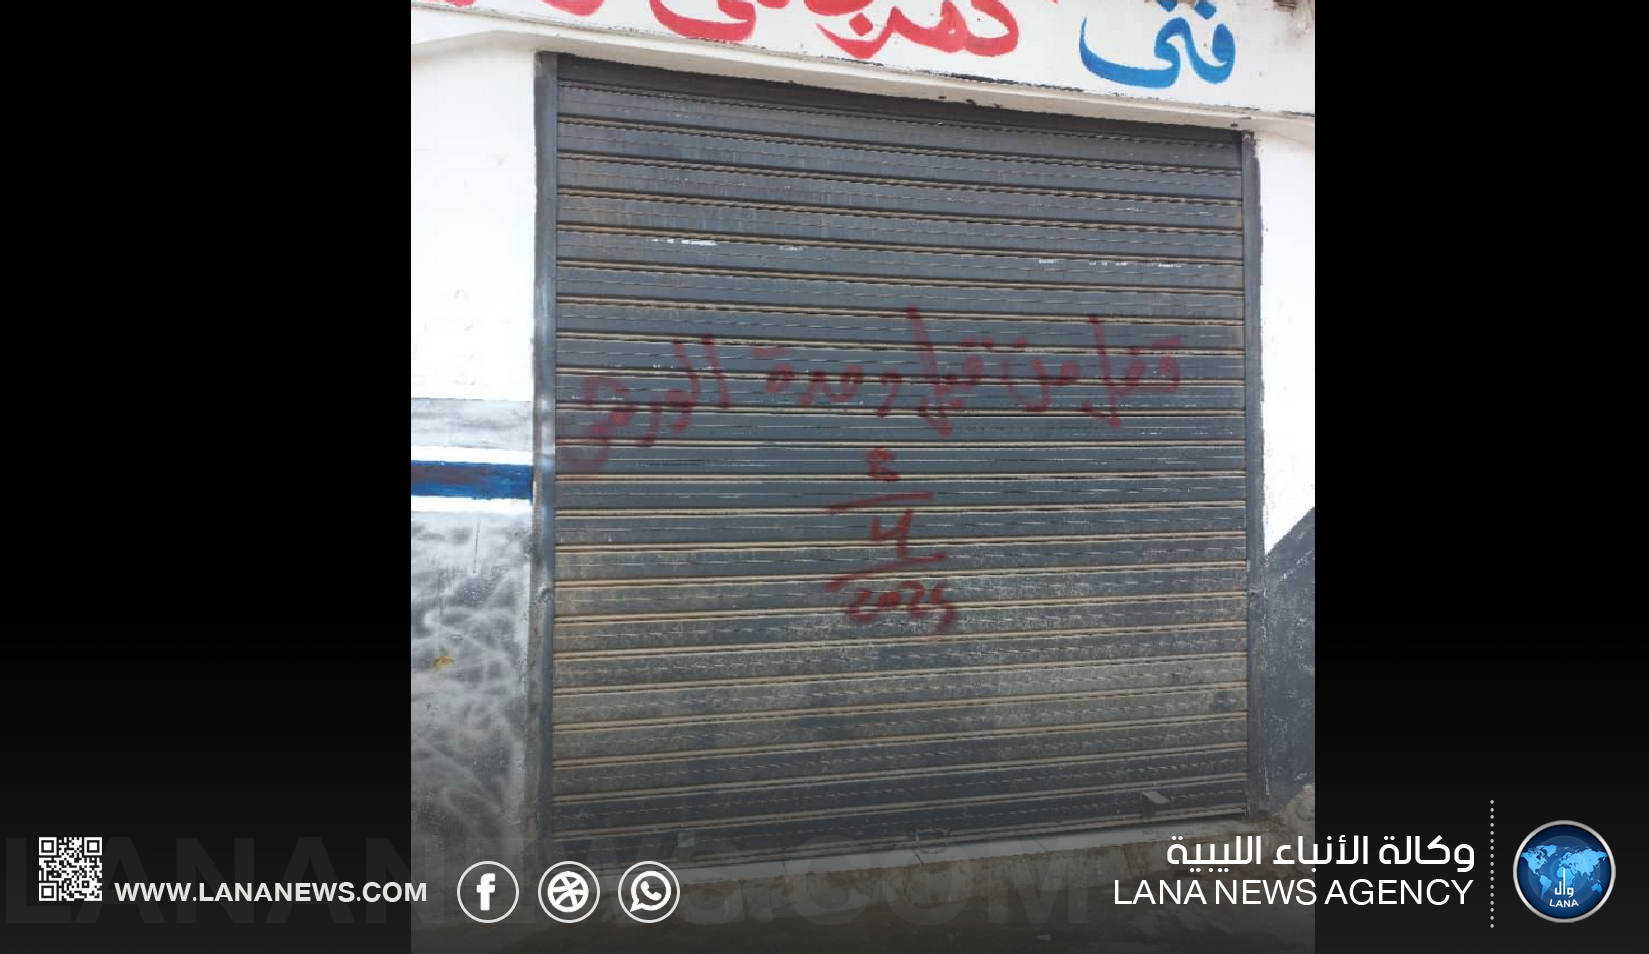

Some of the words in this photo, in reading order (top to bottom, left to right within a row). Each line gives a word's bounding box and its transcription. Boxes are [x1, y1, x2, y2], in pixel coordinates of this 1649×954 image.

[752, 344, 900, 419] وحدة
[906, 305, 997, 439] قبل
[1001, 334, 1080, 415] من
[1075, 314, 1182, 430] قفل
